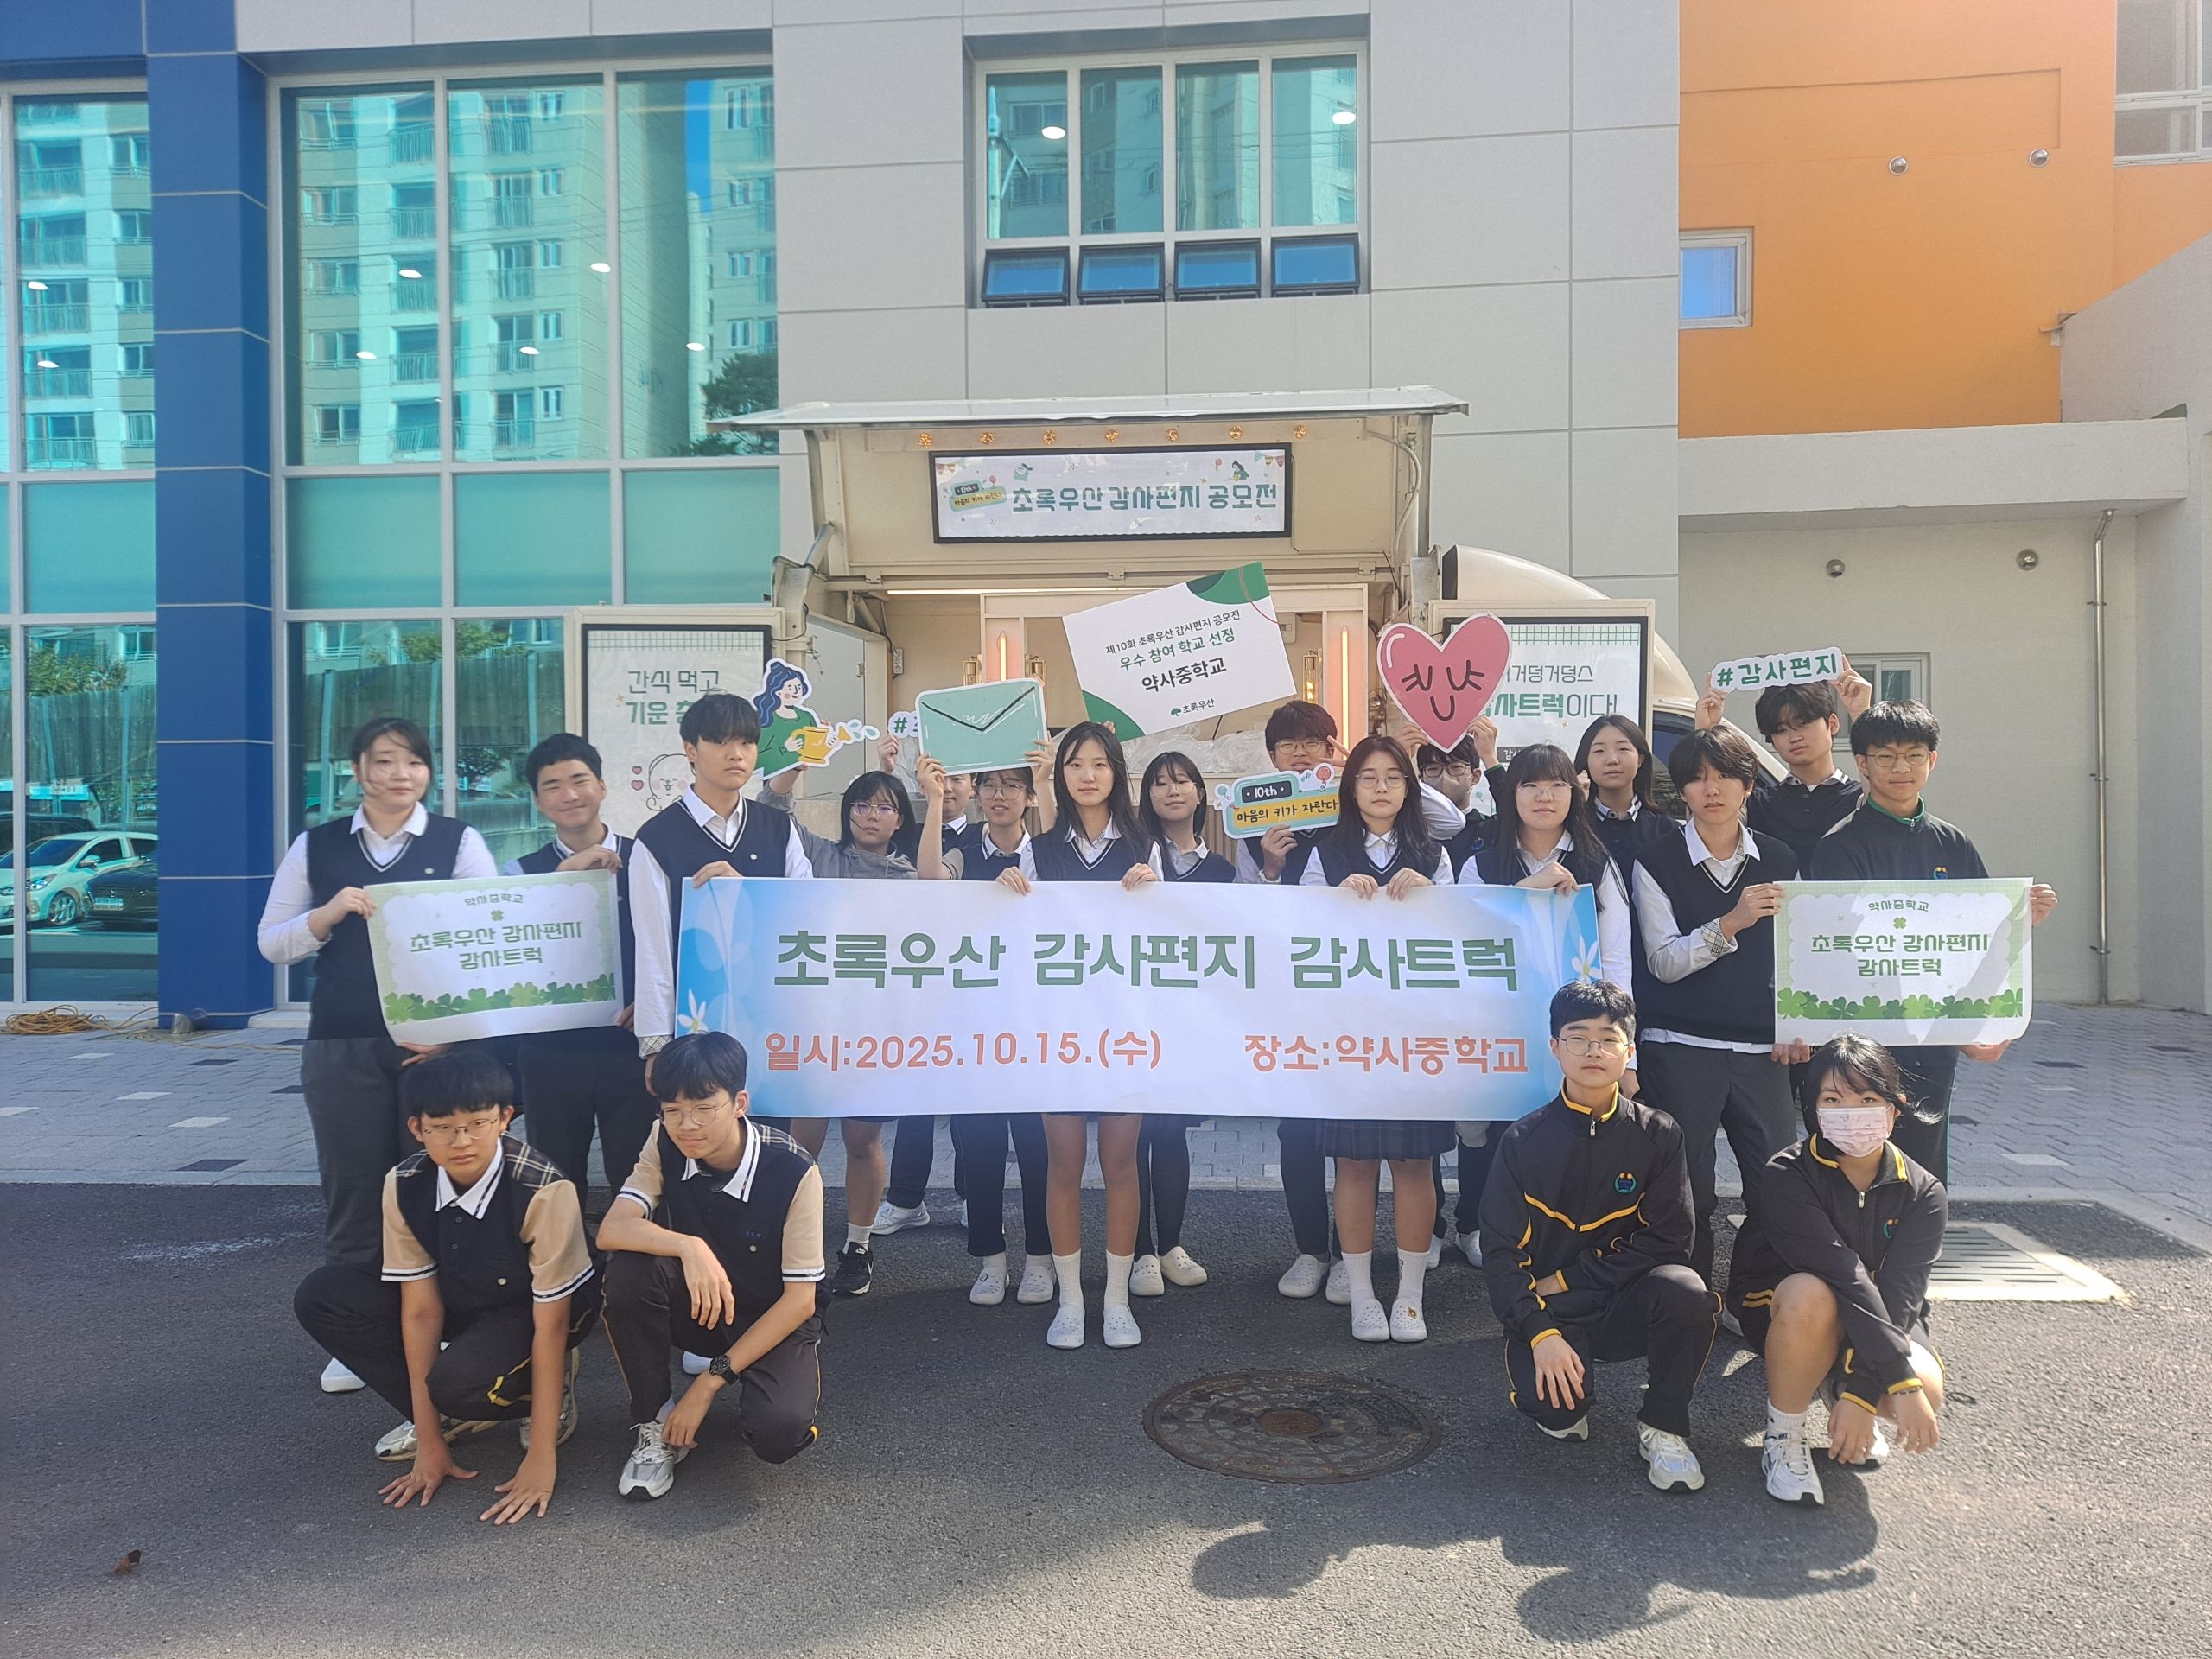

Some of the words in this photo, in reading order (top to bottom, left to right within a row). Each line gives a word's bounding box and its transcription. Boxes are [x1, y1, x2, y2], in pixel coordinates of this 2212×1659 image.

[1012, 486, 1103, 512] 초록우산
[1109, 485, 1201, 510] 감사편지
[1208, 484, 1278, 509] 공모전
[1106, 637, 1136, 655] 제10회
[1137, 628, 1173, 647] 초록우산
[1174, 617, 1211, 637] 감사편지
[1212, 609, 1241, 626] 공모전
[1120, 653, 1146, 671] 우수
[1149, 644, 1176, 664] 참여
[1178, 635, 1206, 655] 학교
[1209, 626, 1236, 645] 선정
[627, 670, 671, 694] 간식
[677, 670, 719, 693] 먹고
[1141, 657, 1227, 693] 약사중학교
[1506, 664, 1594, 683] 거덩거덩스
[1716, 653, 1837, 687] #감사편지
[625, 701, 669, 725] 기운
[1183, 698, 1215, 714] 초록우산
[1483, 693, 1618, 718] 사트럭이다!
[1254, 785, 1278, 798] 10th
[1236, 809, 1268, 823] 마음의
[1274, 804, 1298, 817] 키가
[1302, 798, 1338, 813] 자란다
[464, 893, 524, 906] 약사중학교
[1868, 899, 1929, 912] 약사중학교
[409, 927, 497, 954] 초록우산
[502, 921, 582, 944] 감사편지
[1810, 933, 1896, 954] 초록우산
[1903, 932, 1988, 953] 감사편지
[459, 946, 543, 971] 감사트럭
[774, 930, 1007, 989] 초록우산
[1035, 933, 1255, 990] 감사편지
[1290, 935, 1518, 992] 감사트럭
[1858, 957, 1942, 977] 감사트럭
[1245, 1033, 1529, 1076] 장소:약사중학교
